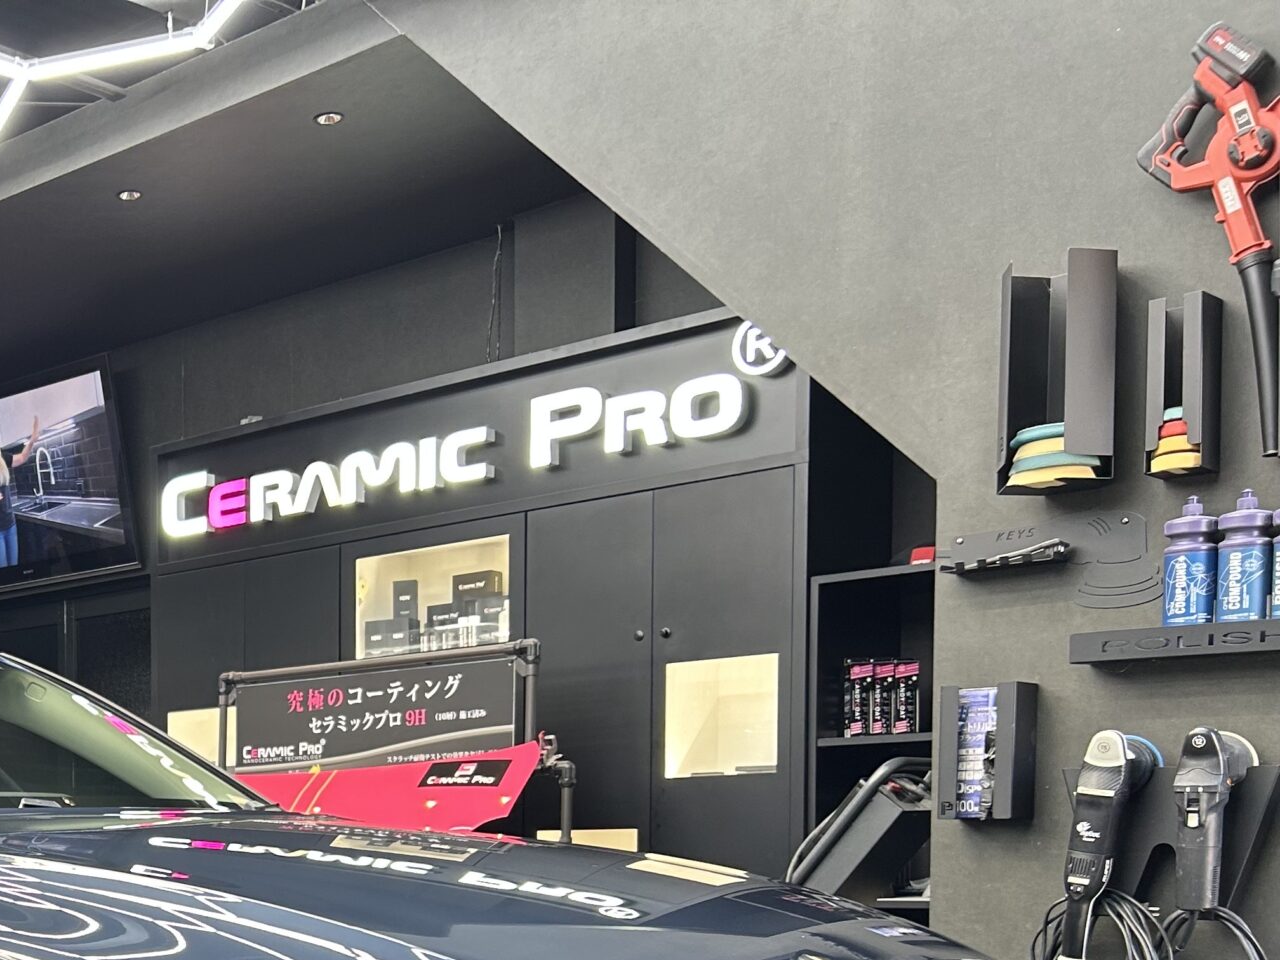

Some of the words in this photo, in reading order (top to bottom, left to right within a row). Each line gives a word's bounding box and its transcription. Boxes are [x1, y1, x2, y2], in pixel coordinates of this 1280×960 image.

[161, 425, 496, 538] CERAMIC
[995, 527, 1036, 543] KEYS
[1174, 558, 1187, 615] COMPOUND
[1228, 551, 1242, 610] COMPOUND
[286, 673, 463, 713] 究極のコーティング
[242, 745, 294, 759] CERAMIC
